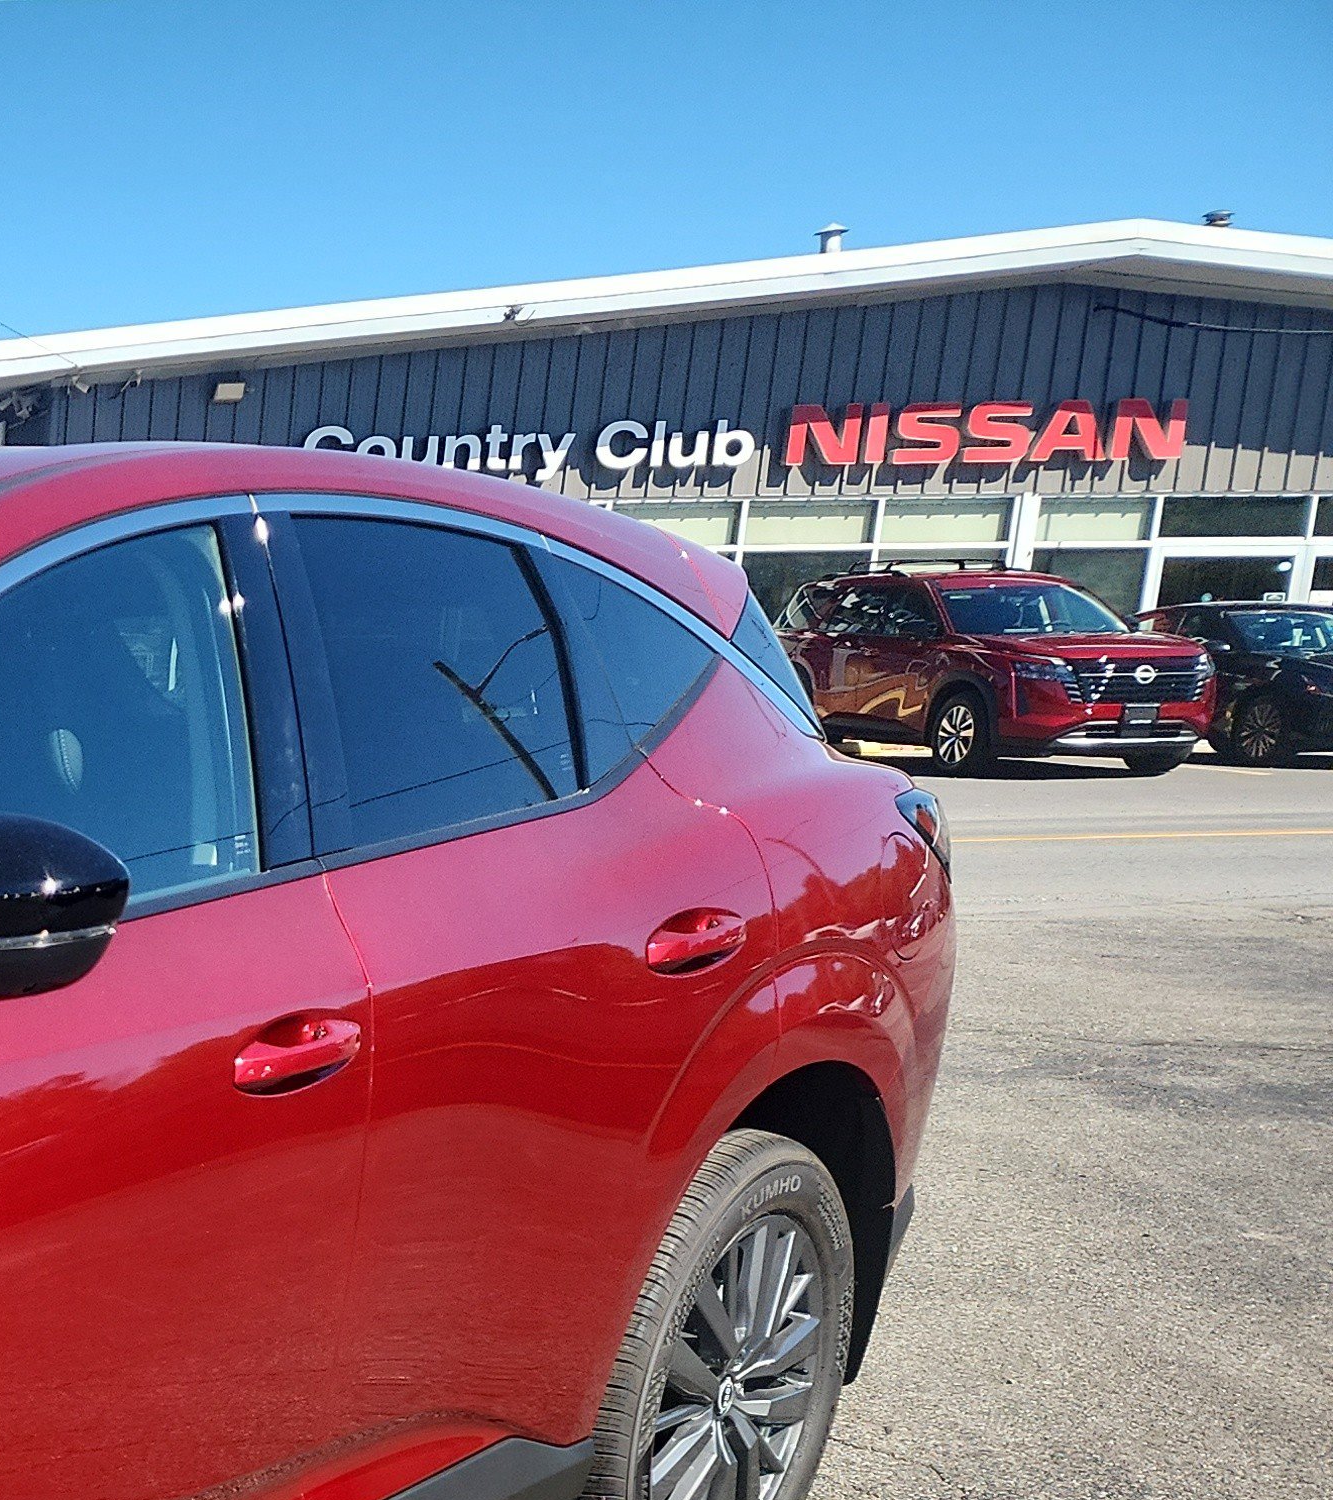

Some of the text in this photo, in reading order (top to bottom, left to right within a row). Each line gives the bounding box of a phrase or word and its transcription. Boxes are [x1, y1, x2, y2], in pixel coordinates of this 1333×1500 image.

[304, 418, 755, 481] Country Club
[784, 398, 1189, 466] NISSAN
[741, 1174, 802, 1219] KUMHO
